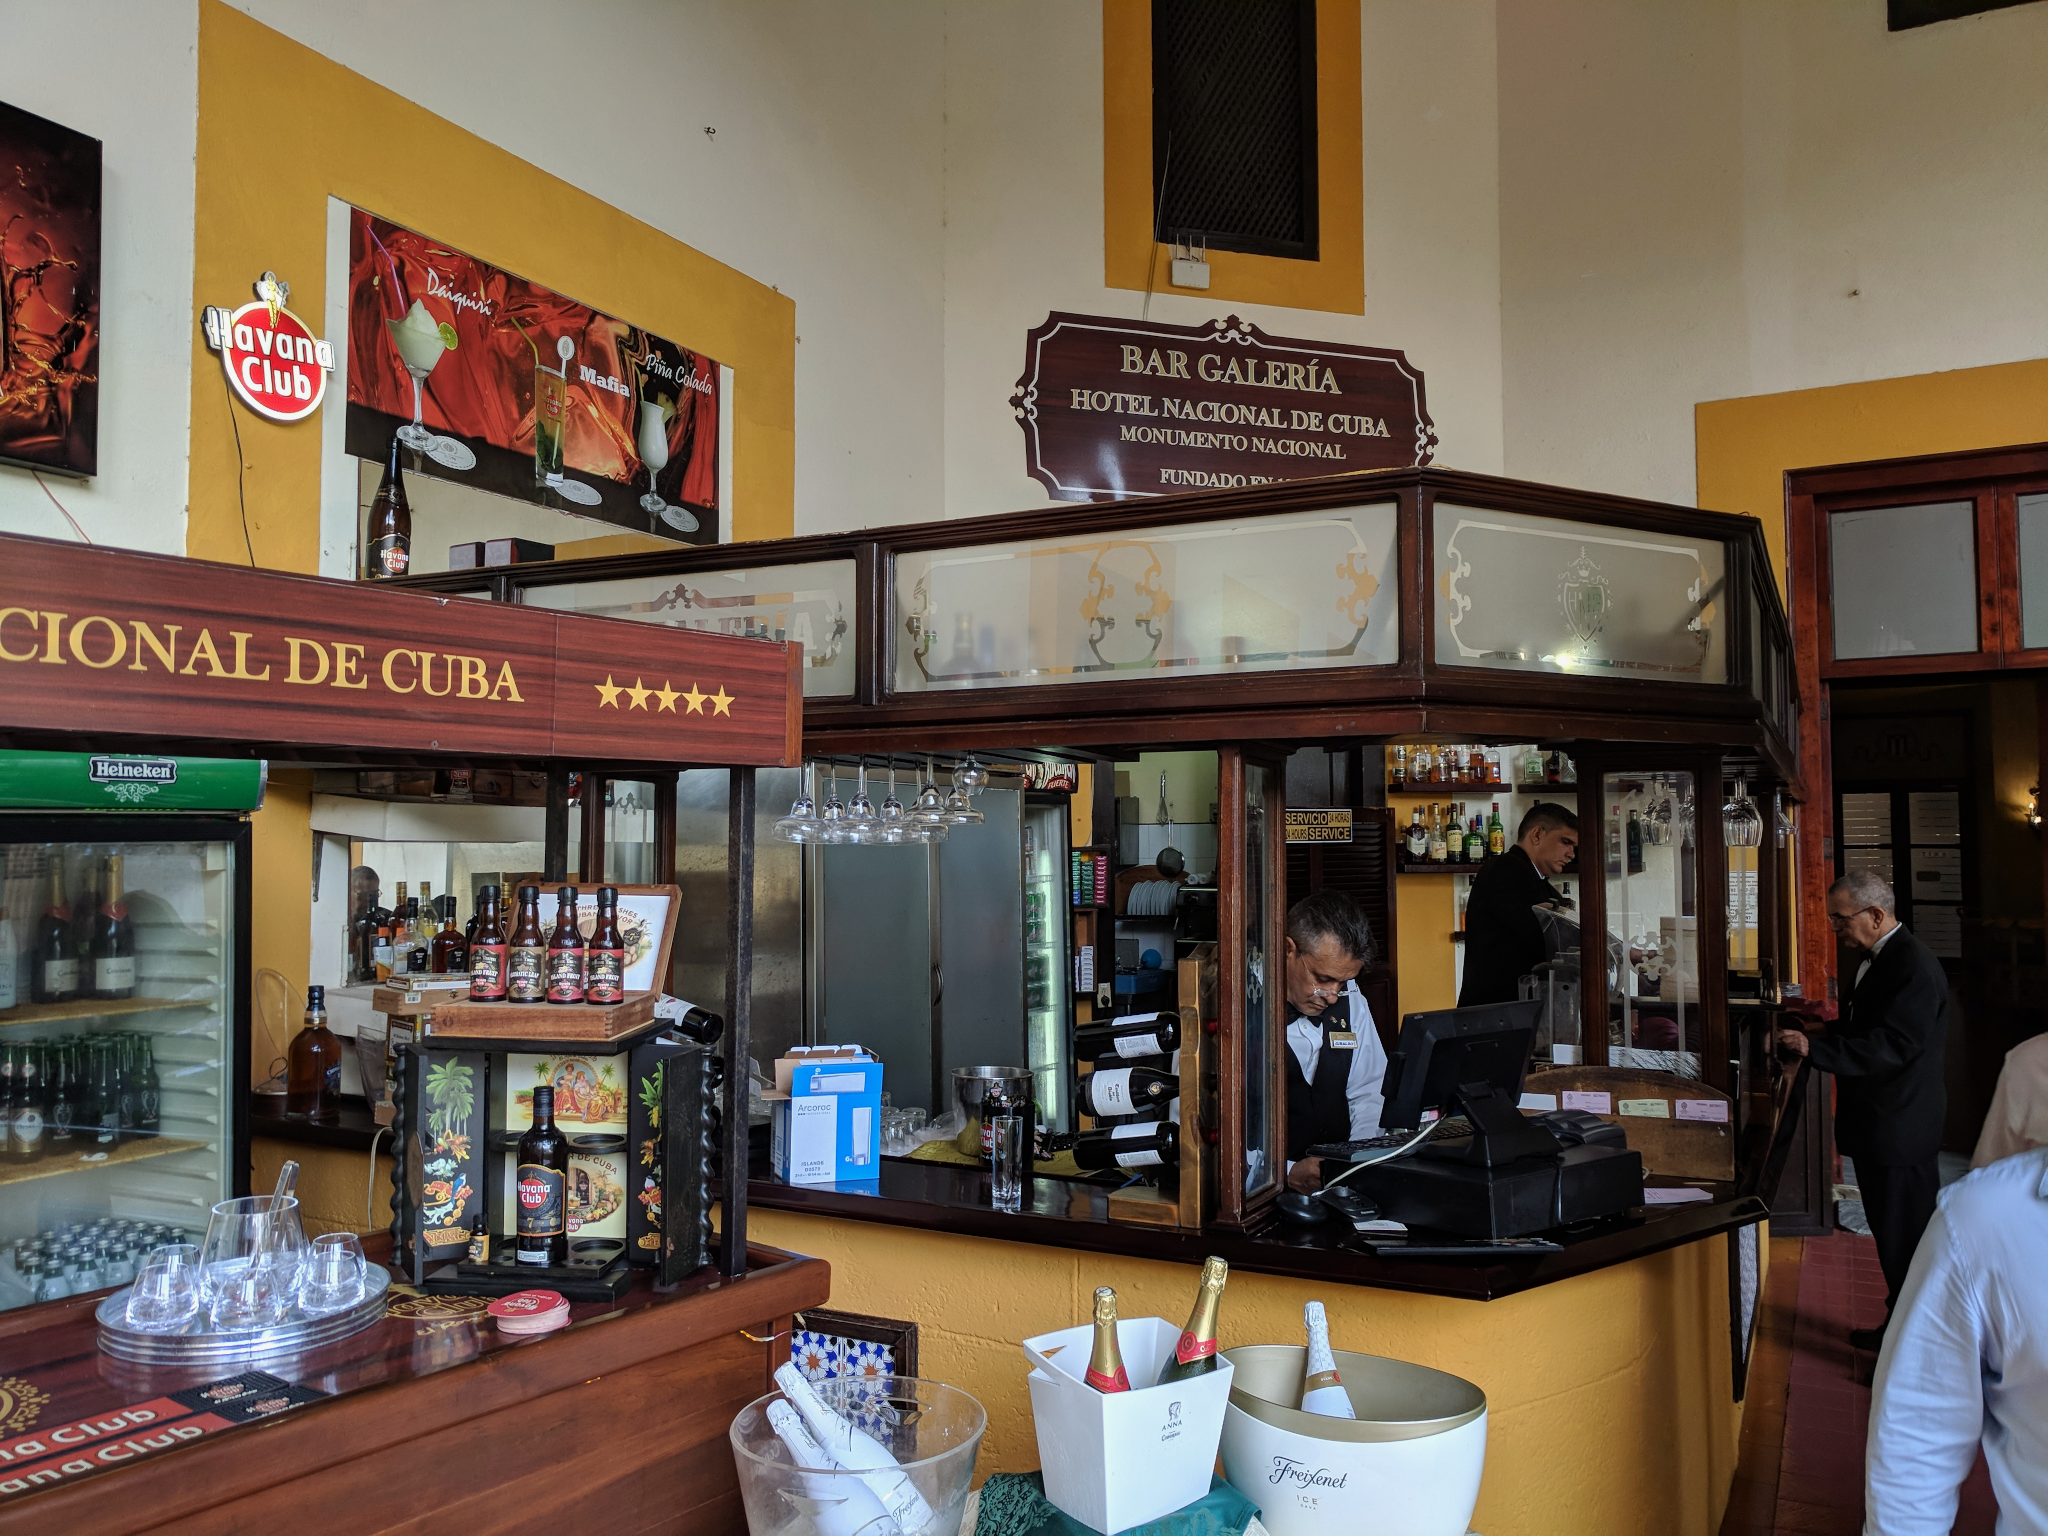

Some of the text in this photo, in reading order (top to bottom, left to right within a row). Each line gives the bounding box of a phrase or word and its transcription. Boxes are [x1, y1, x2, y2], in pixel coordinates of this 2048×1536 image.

[210, 309, 335, 370] Havana
[241, 356, 313, 401] Club
[646, 353, 713, 396] Piña Colada
[1120, 344, 1343, 395] BAR GALERÍA
[579, 365, 631, 398] Mafia
[1070, 388, 1391, 438] HOTEL NACIONAL DE CUBA
[1119, 425, 1347, 460] MONUMENTO NACIONAL
[1159, 468, 1247, 489] FUNDADO
[387, 559, 405, 569] Club
[0, 607, 525, 703] CIONAL DE CUBA
[96, 760, 174, 780] Heineken
[1047, 779, 1069, 789] FUERTE
[1285, 812, 1328, 825] SERVICIO
[1308, 828, 1350, 840] SERVICE
[797, 1103, 832, 1112] Arcoroc
[578, 1154, 591, 1162] DE
[593, 1156, 618, 1175] CUBA
[517, 1181, 552, 1193] Havana
[521, 1192, 542, 1204] Club
[526, 1217, 535, 1229] 7
[51, 1408, 157, 1444] Club
[1161, 1420, 1183, 1431] ANNA
[98, 1424, 204, 1462] Club
[1269, 1455, 1348, 1490] Freixenet
[1296, 1494, 1318, 1506] ICE
